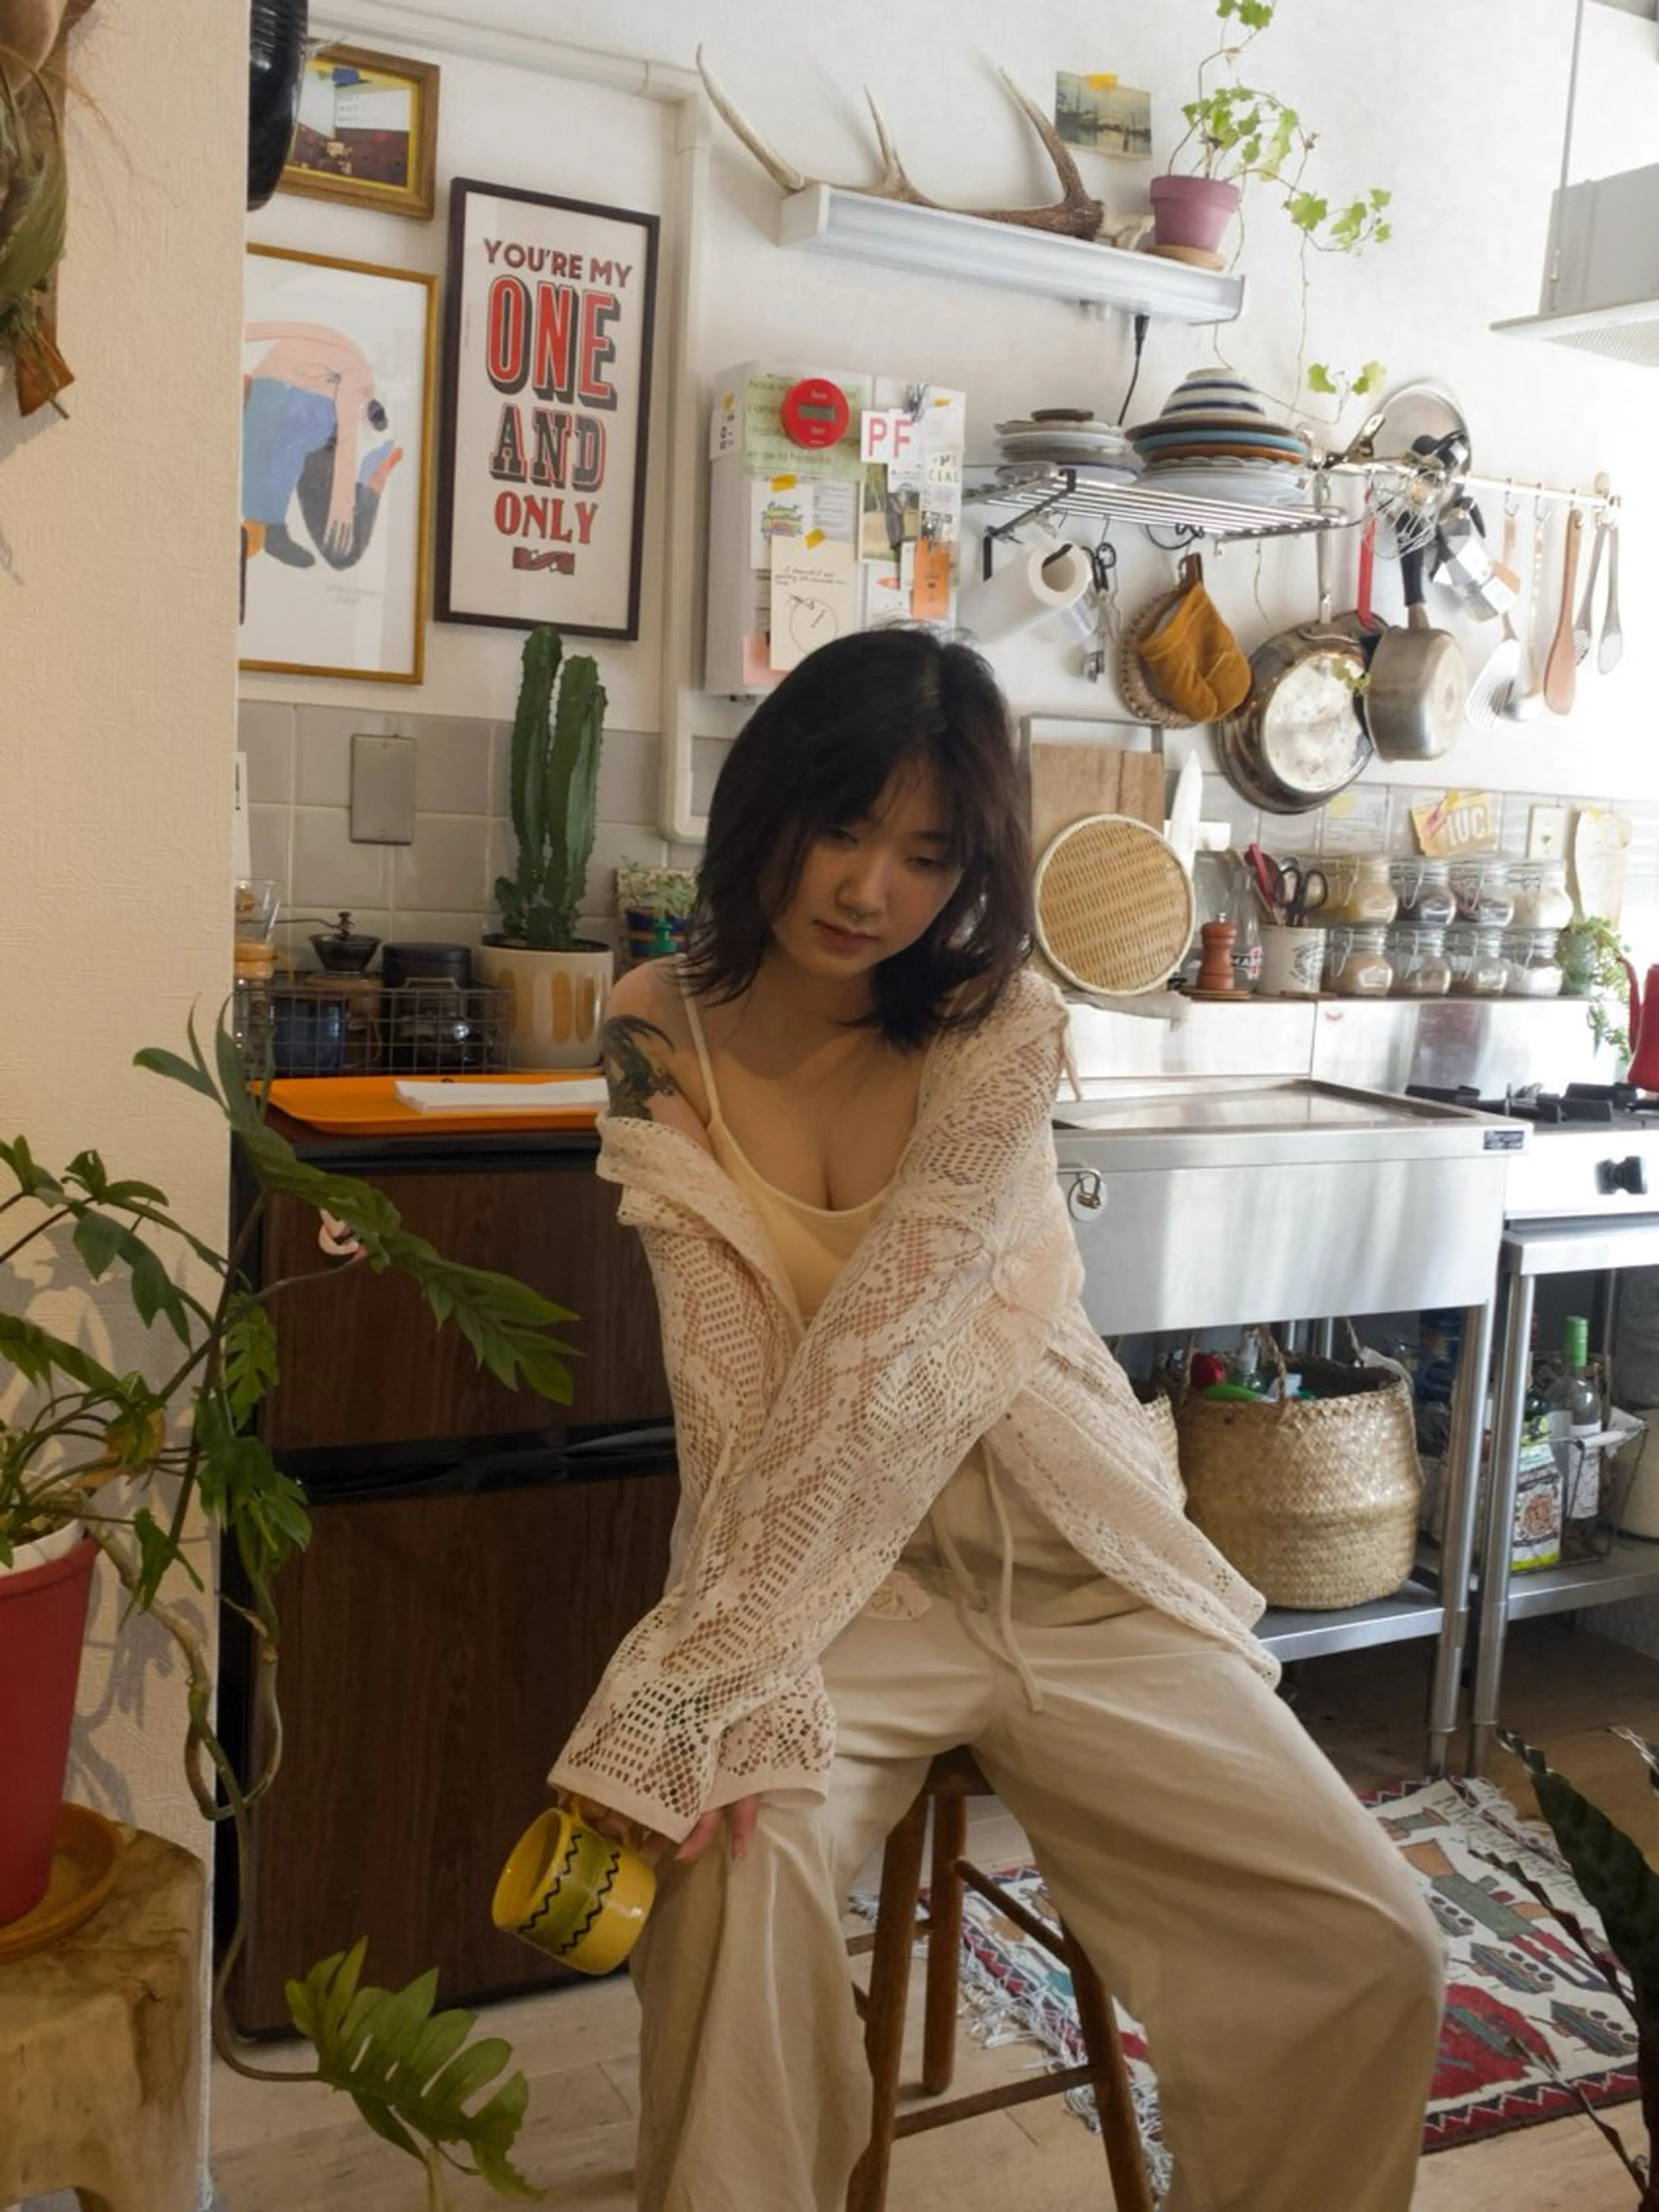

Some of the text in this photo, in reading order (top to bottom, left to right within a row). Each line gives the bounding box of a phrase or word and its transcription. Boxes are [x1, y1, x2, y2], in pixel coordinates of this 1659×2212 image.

[483, 237, 632, 288] YOU'RE MY
[486, 274, 621, 410] ONE
[489, 403, 607, 493] AND
[494, 490, 598, 545] ONLY
